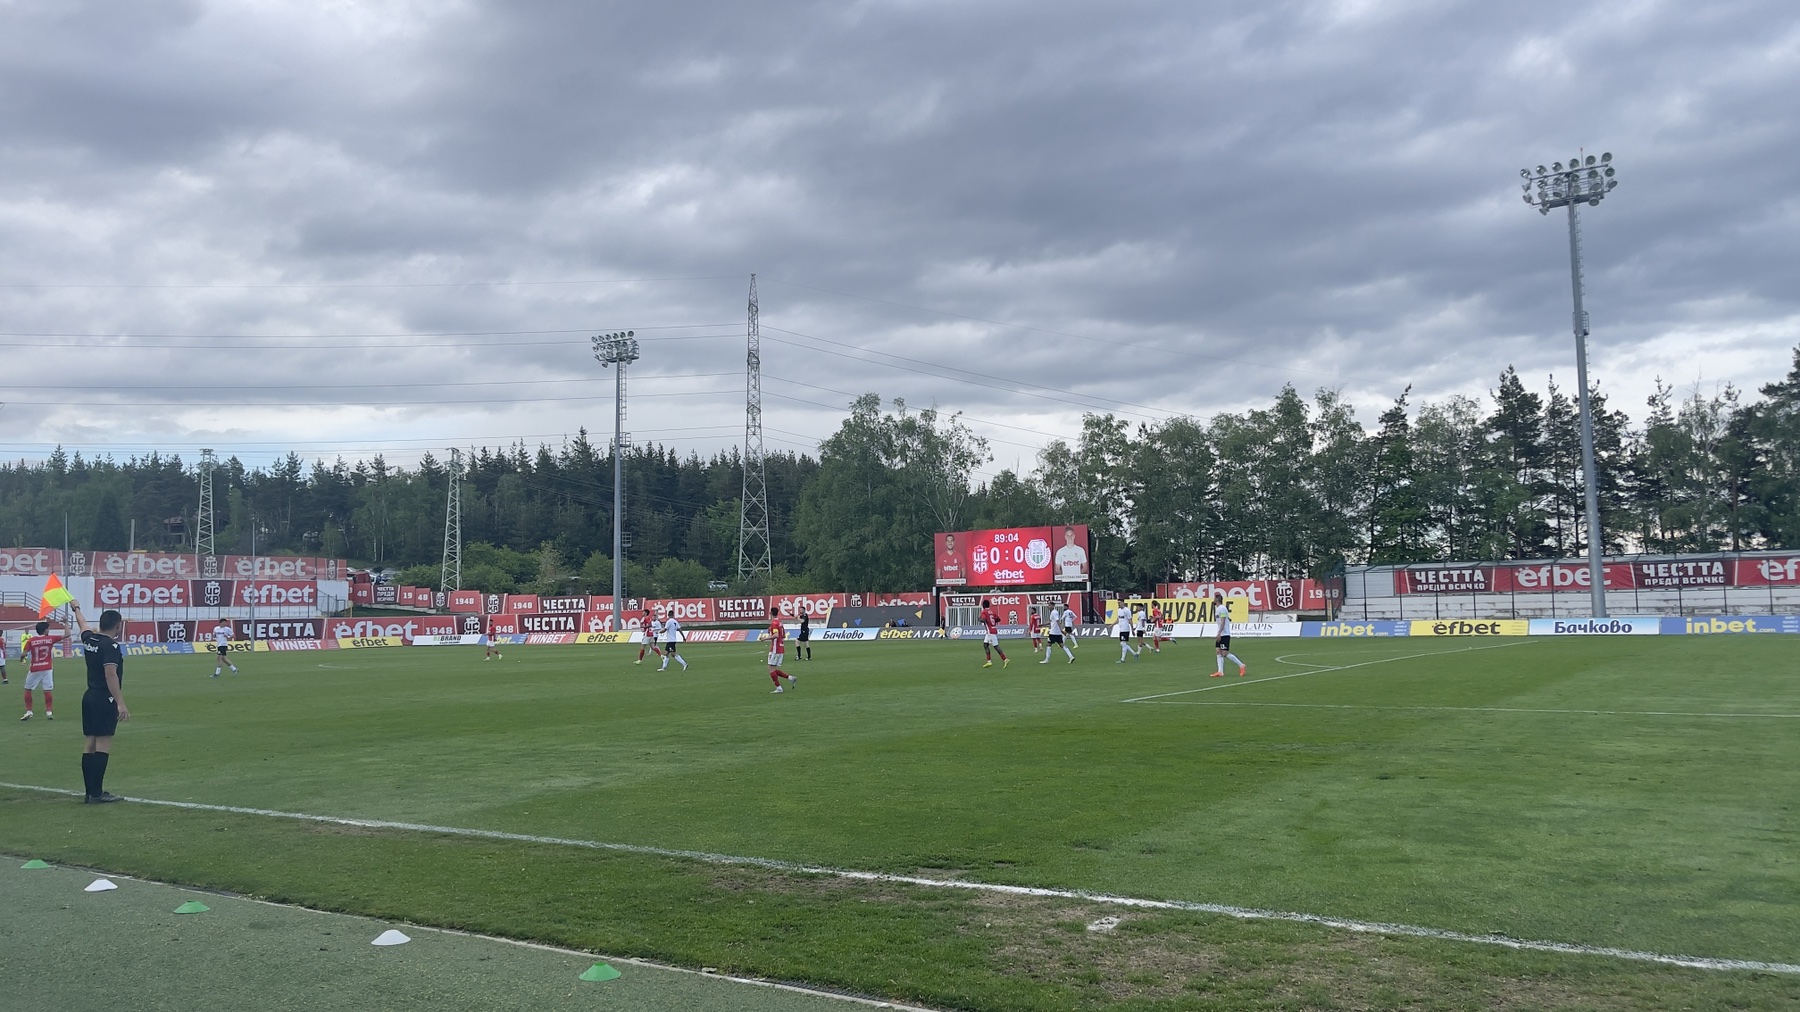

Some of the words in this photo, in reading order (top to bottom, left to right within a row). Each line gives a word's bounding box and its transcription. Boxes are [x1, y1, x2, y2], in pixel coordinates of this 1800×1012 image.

[994, 533, 1019, 543] 89:04
[990, 547, 1000, 564] 0
[1014, 546, 1024, 563] 0
[104, 553, 187, 574] efbet
[235, 557, 306, 576] efbet
[993, 569, 1024, 579] efbet
[1642, 562, 1724, 577] ЧЕСТТА
[1415, 569, 1485, 583] ЧЕСТТА
[1645, 577, 1679, 586] ПРЕДИ
[1682, 576, 1725, 585] ВСИЧКО
[1448, 582, 1485, 590] ВСИЧКО
[98, 583, 183, 604] efbet
[241, 585, 314, 603] efbet
[417, 593, 429, 601] 48
[1309, 589, 1339, 598] 1948
[543, 598, 586, 610] ЧЕСТТА
[719, 598, 765, 611] ЧЕСТТА
[779, 595, 838, 616] efbet
[990, 596, 1020, 605] efbet
[652, 601, 706, 619] efbet
[741, 610, 765, 618] ВСИЧКО
[524, 616, 576, 631] ЧЕСТТА
[989, 614, 996, 625] 6
[243, 623, 315, 638] ЧЕСТТА
[333, 620, 418, 641] efbet
[426, 627, 453, 635] 1948
[1432, 621, 1501, 635] efbet
[1554, 620, 1633, 634] Бачково
[529, 634, 567, 643] WINBET
[587, 633, 618, 643] efbet
[689, 630, 735, 641] WINBET
[823, 629, 864, 639] Бачково
[880, 629, 913, 639] efbet
[272, 640, 322, 650] WINBET
[351, 637, 389, 647] efbet
[35, 645, 50, 662] 13
